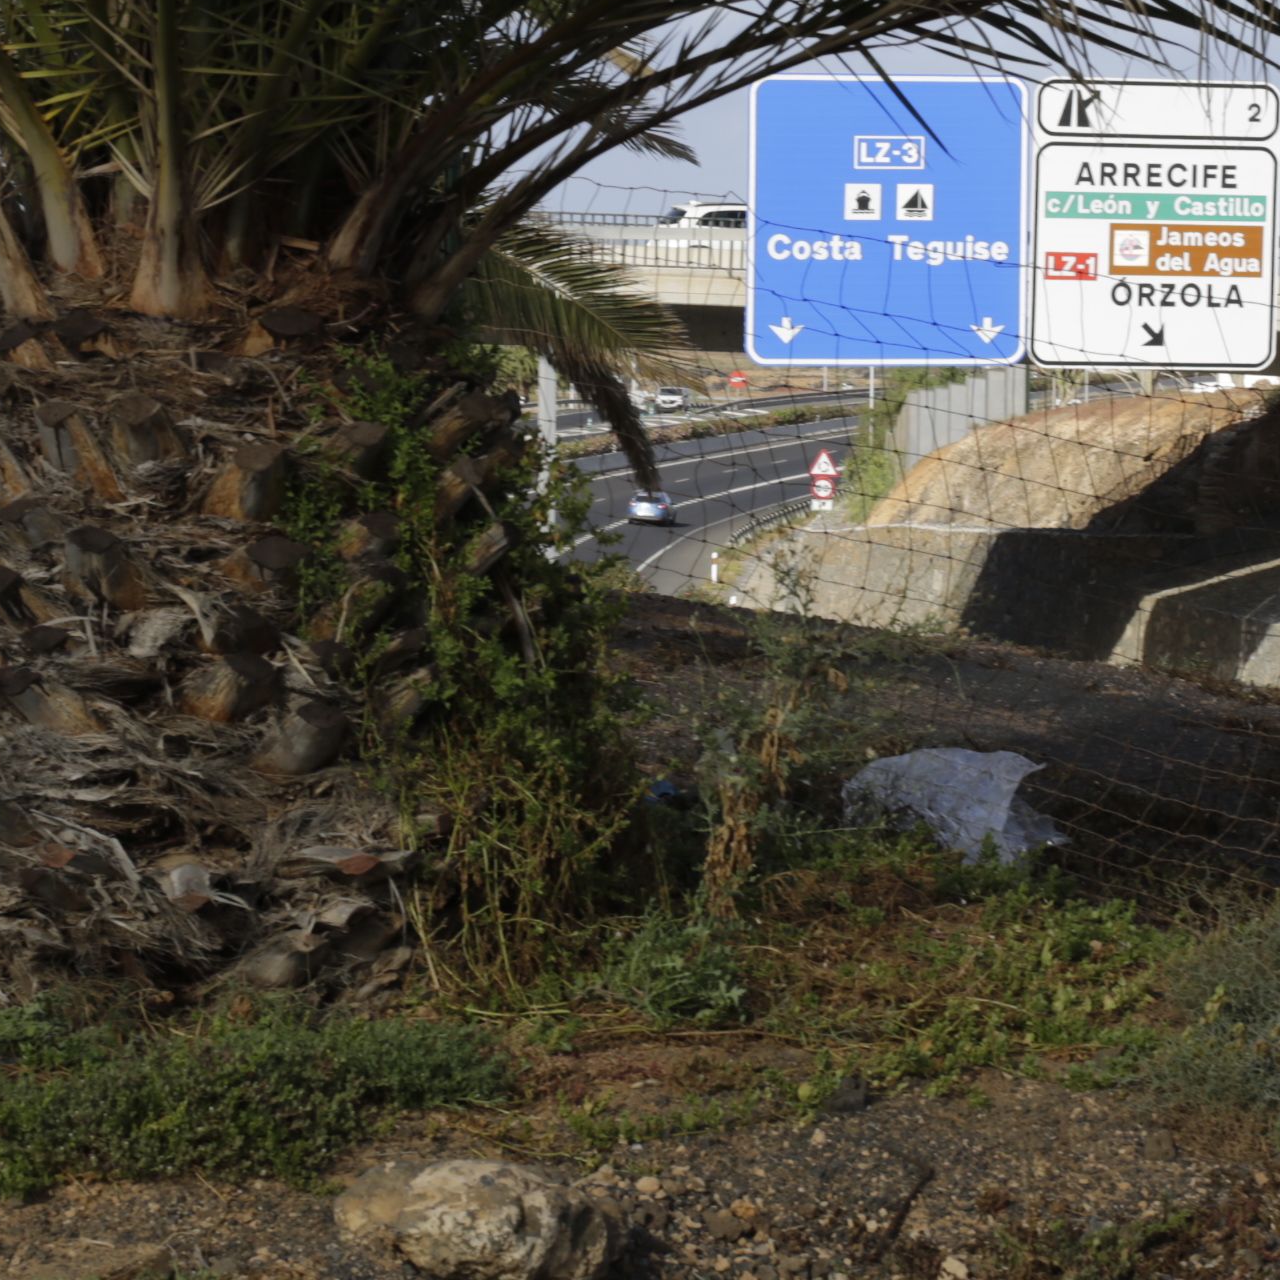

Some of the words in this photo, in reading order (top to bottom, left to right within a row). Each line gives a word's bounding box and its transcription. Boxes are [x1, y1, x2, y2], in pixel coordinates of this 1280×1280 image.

[1248, 103, 1261, 122] 2
[860, 141, 919, 163] LZ-3
[1075, 162, 1237, 189] ARRECIFE
[1047, 195, 1132, 215] c/León
[1146, 200, 1160, 219] y
[1174, 196, 1265, 217] Castillo
[1156, 227, 1245, 247] Jameos
[767, 233, 863, 261] Costa
[887, 234, 1009, 266] Teguise
[1048, 255, 1097, 277] LZ-1
[1156, 253, 1192, 271] del
[1204, 253, 1260, 275] Agua
[1111, 277, 1243, 308] ÓRZOLA
